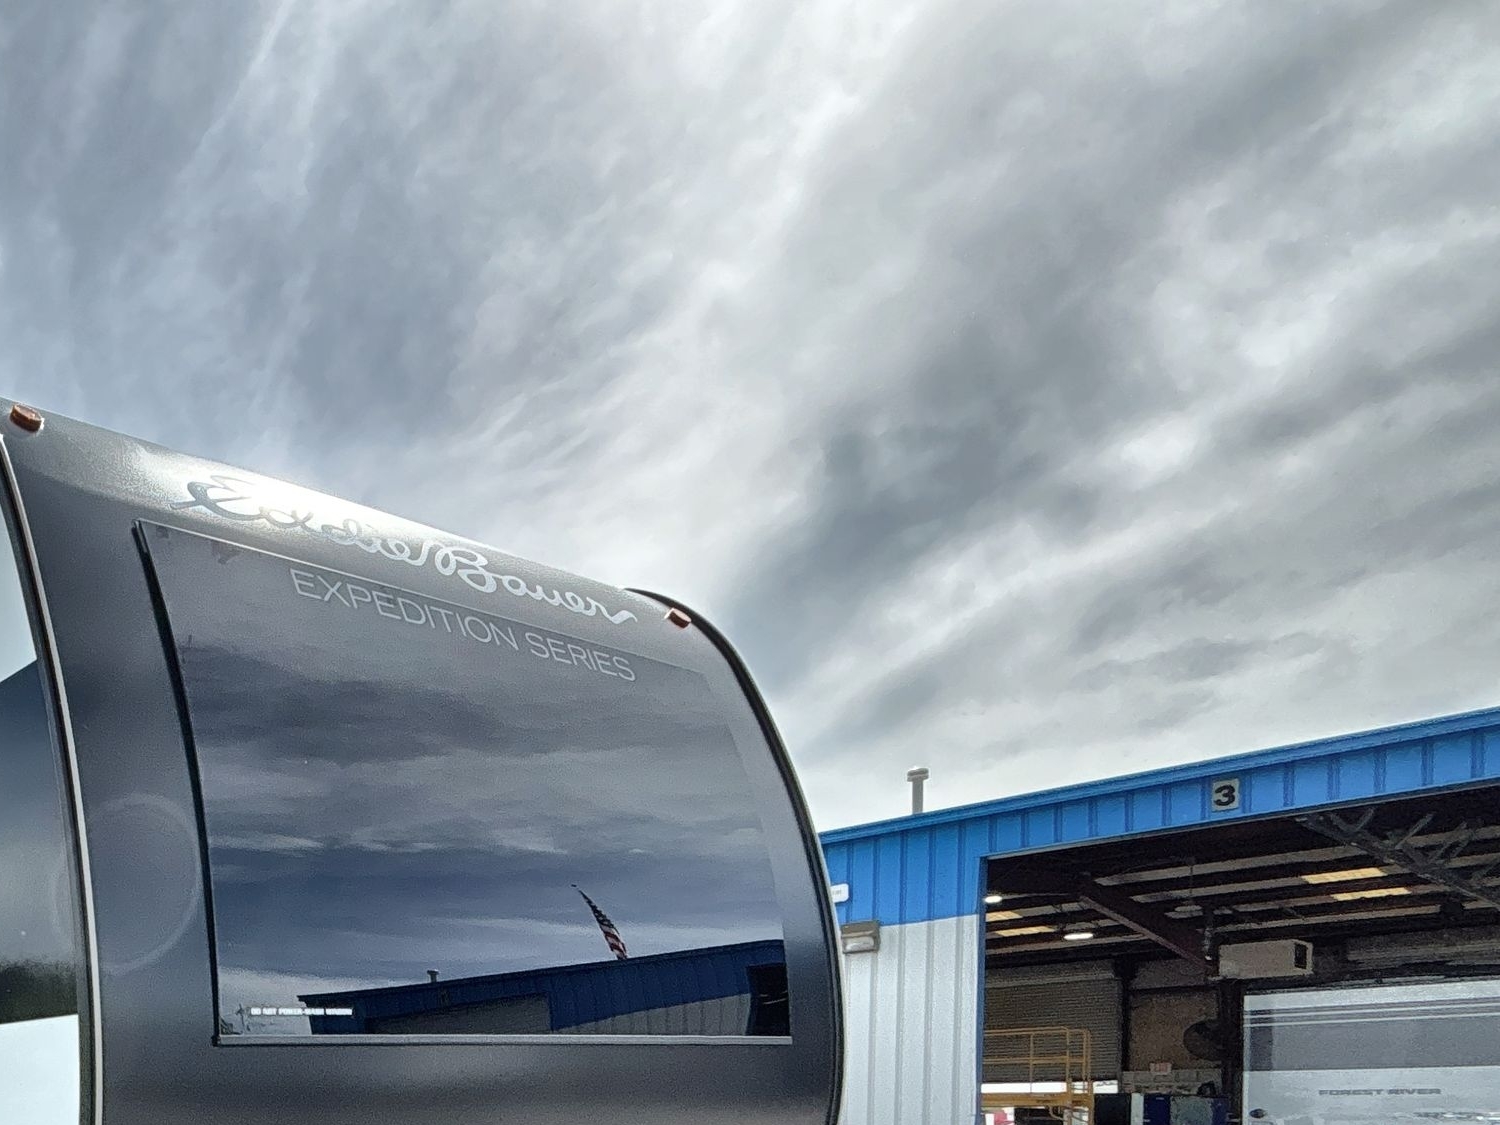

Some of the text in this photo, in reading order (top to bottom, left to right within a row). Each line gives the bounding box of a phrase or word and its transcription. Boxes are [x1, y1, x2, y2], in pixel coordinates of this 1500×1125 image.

[430, 542, 638, 626] Bauer
[288, 566, 637, 682] EXPEDITION SERIES
[1214, 784, 1236, 806] 3
[1318, 1088, 1384, 1096] FOREST
